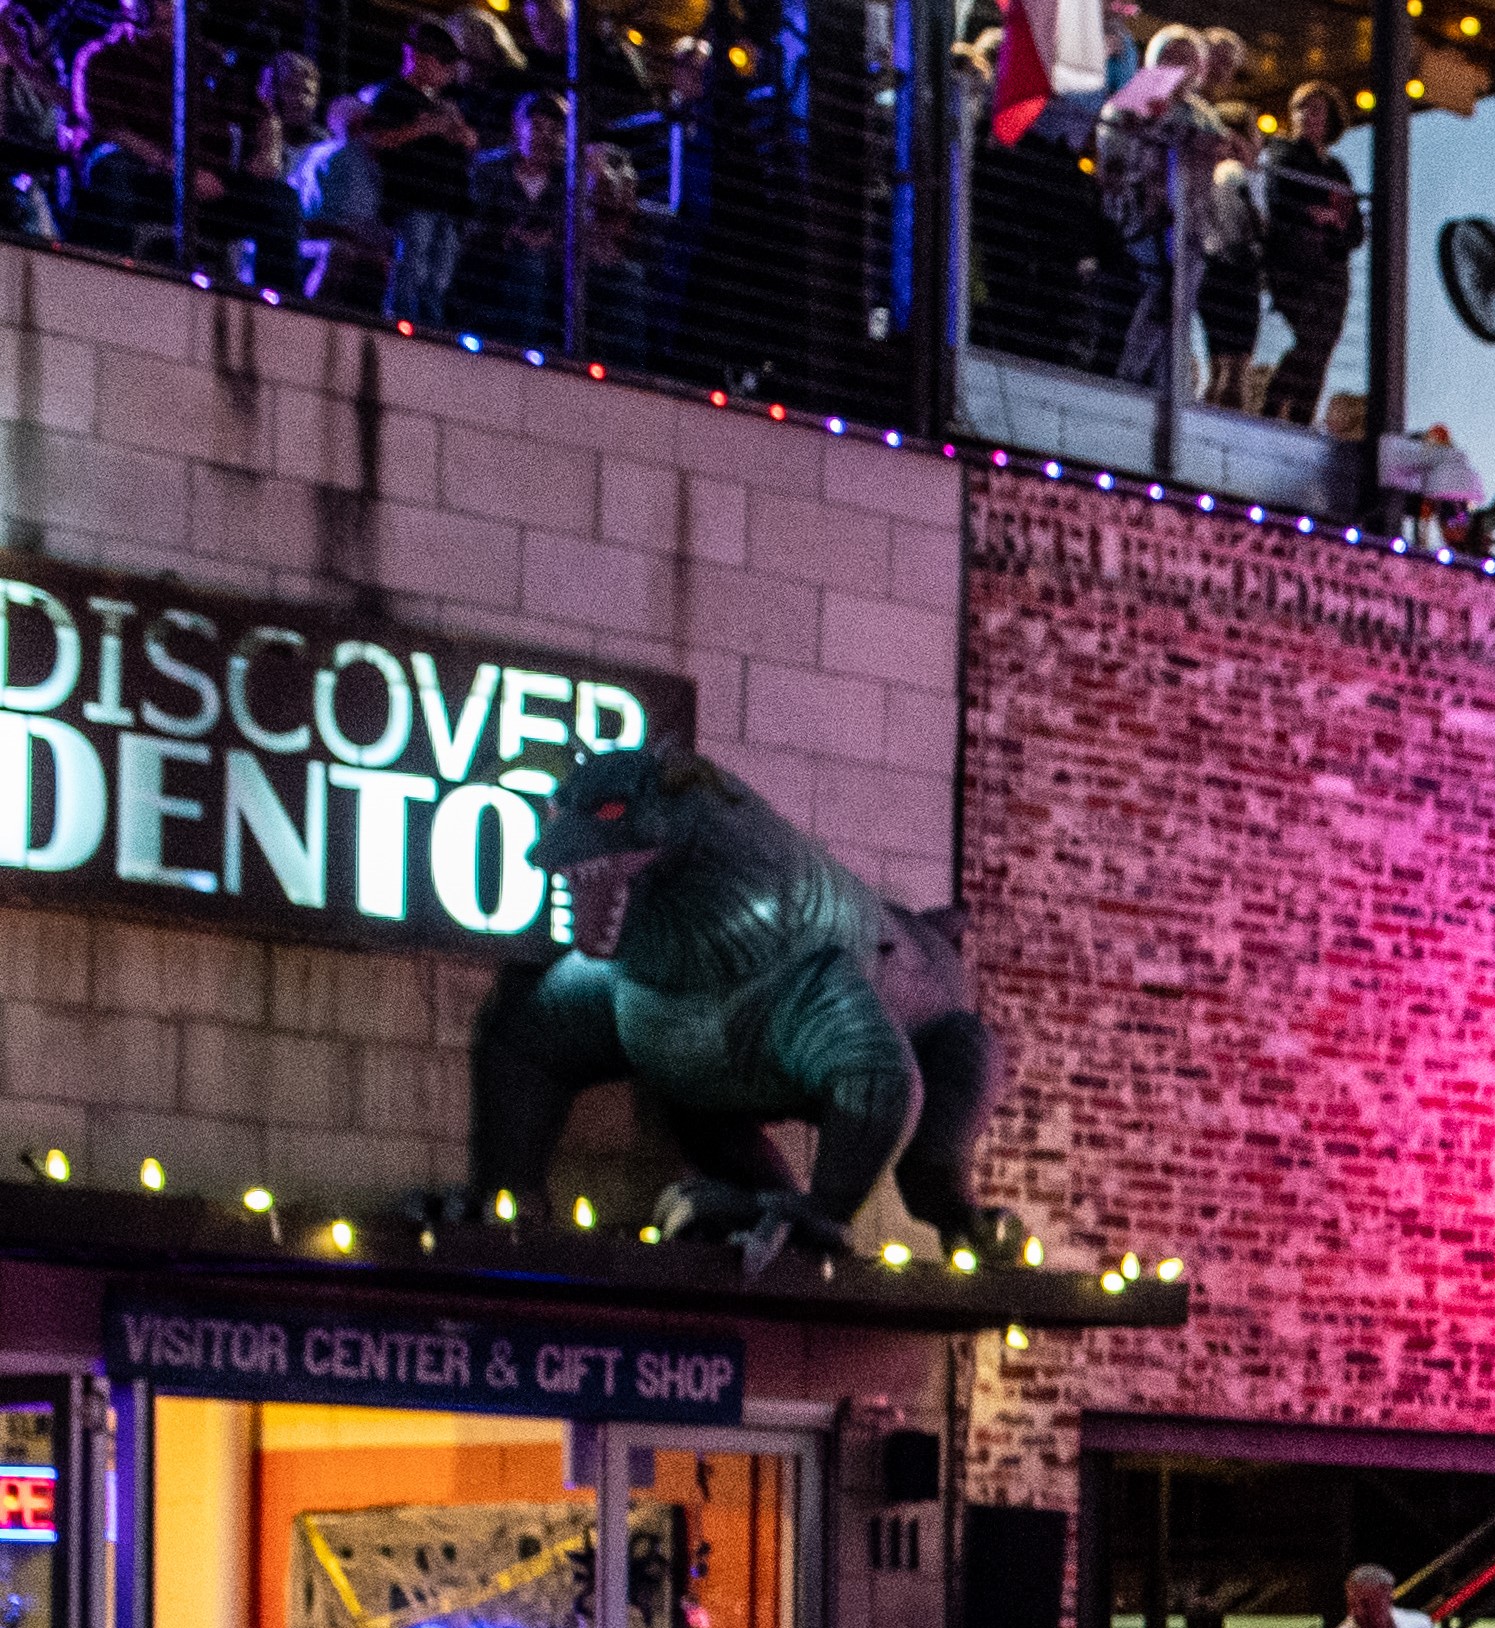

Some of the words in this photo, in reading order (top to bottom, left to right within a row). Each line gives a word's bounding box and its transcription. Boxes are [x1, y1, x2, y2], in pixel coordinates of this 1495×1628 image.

[0, 712, 575, 944] DENTO
[124, 1313, 289, 1376] VISITOR
[303, 1326, 470, 1387] CENTER
[487, 1340, 520, 1385] &
[536, 1344, 625, 1397] GIFT
[637, 1351, 735, 1401] SHOP
